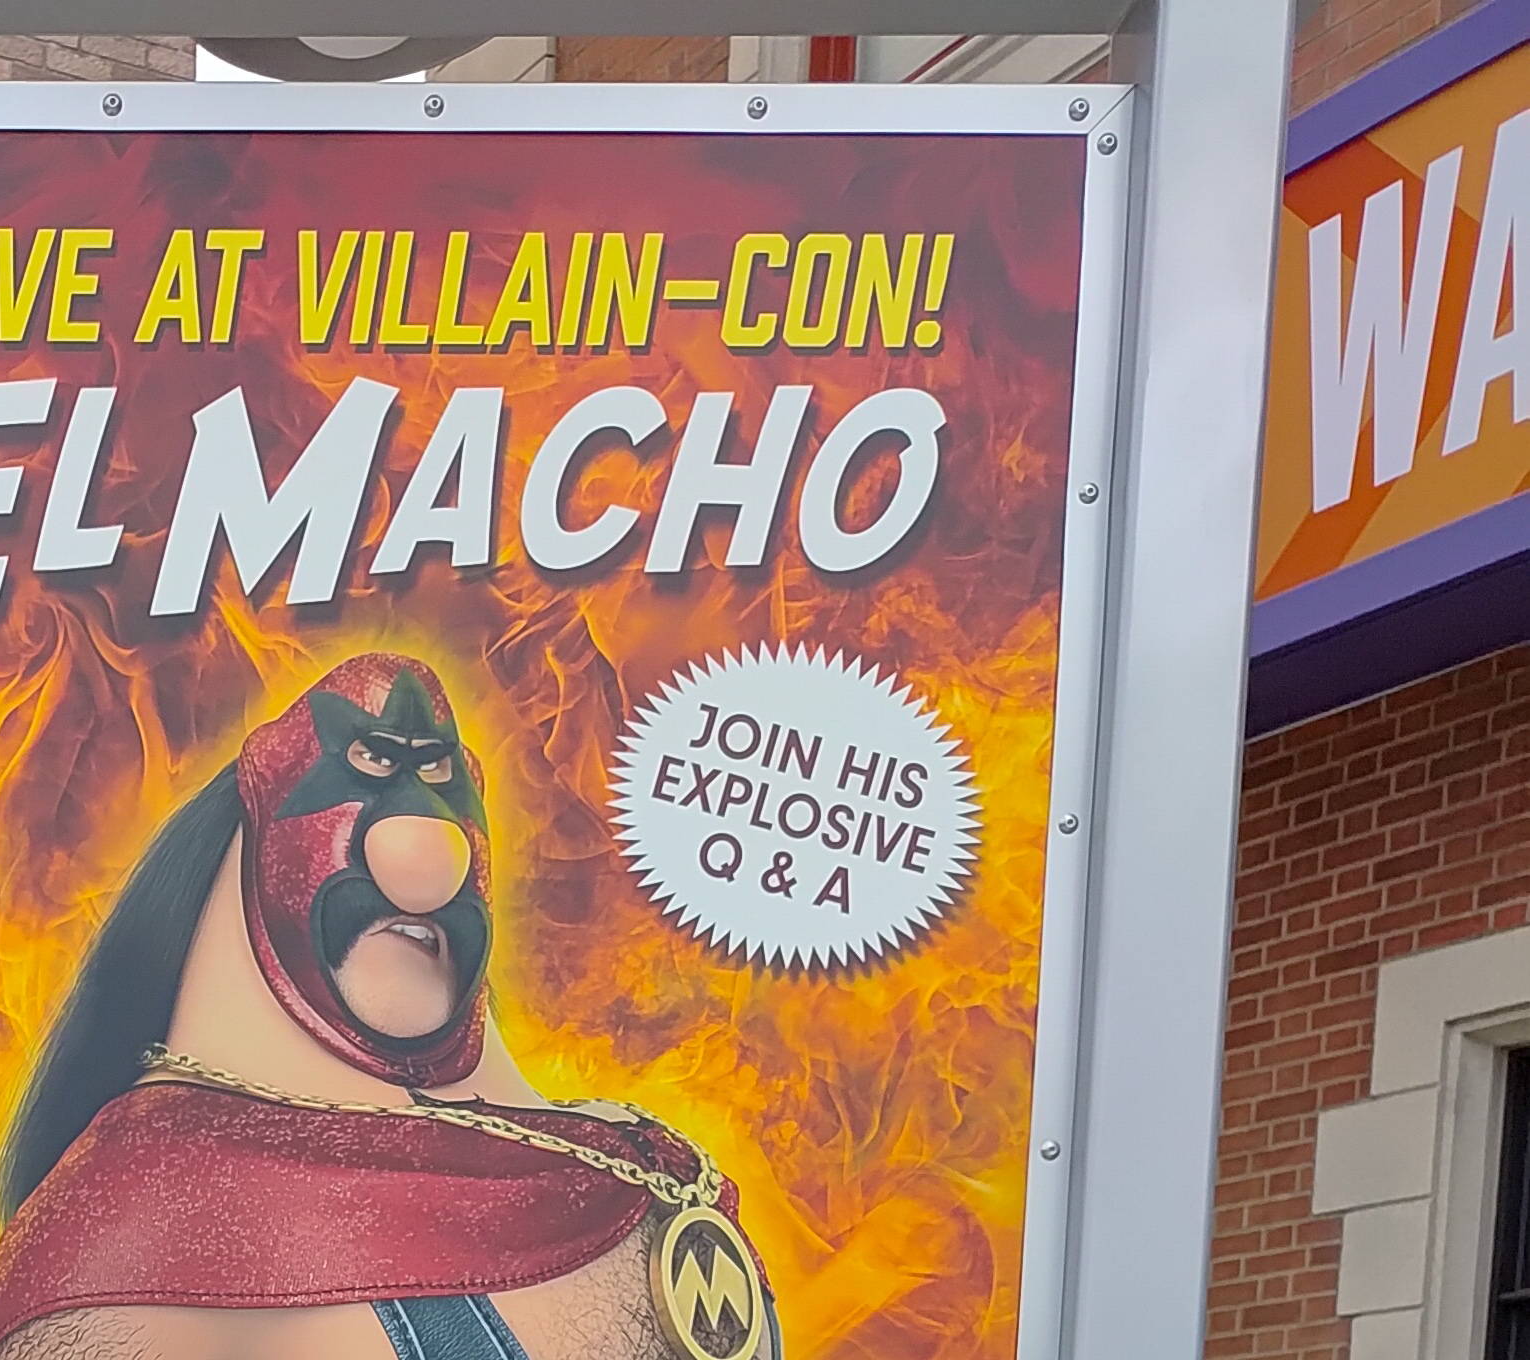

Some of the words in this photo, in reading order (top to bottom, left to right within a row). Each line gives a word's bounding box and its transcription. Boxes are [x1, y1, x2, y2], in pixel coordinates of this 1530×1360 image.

[133, 228, 265, 344] AT
[297, 229, 955, 348] VILLAIN-CON!
[1308, 108, 1530, 515] WA
[149, 376, 949, 617] MACHO
[651, 755, 936, 874] EXPLOSIVE
[689, 703, 823, 780] JOIN
[837, 745, 929, 808] HIS
[699, 832, 743, 883] Q
[760, 851, 797, 898] &
[812, 866, 850, 915] A
